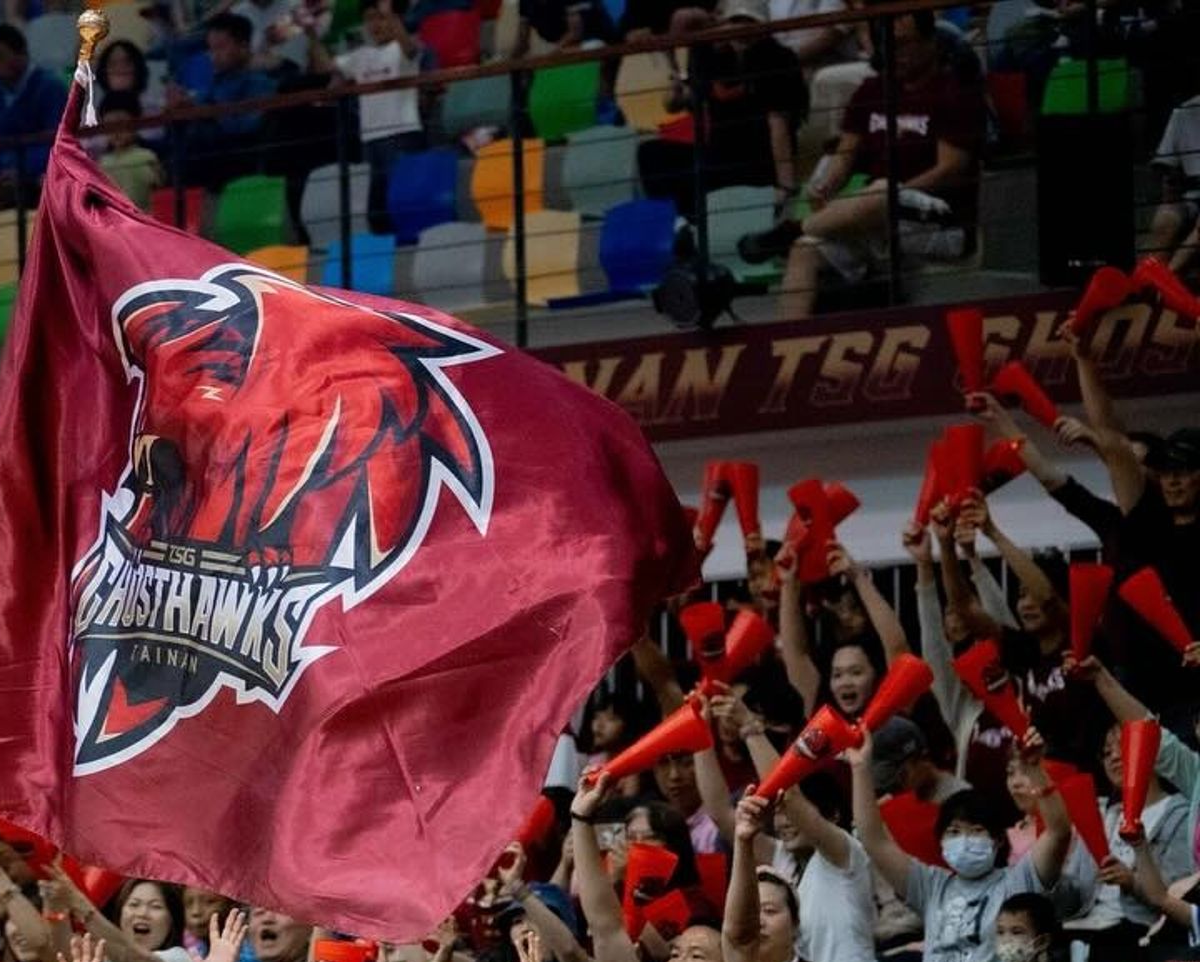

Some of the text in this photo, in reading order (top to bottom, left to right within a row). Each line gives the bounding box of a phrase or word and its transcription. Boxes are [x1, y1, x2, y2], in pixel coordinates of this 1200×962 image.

[757, 325, 932, 413] TSG
[168, 545, 197, 567] TSG
[74, 538, 331, 689] GHOSTHAWKS
[130, 643, 200, 675] TAINAN
